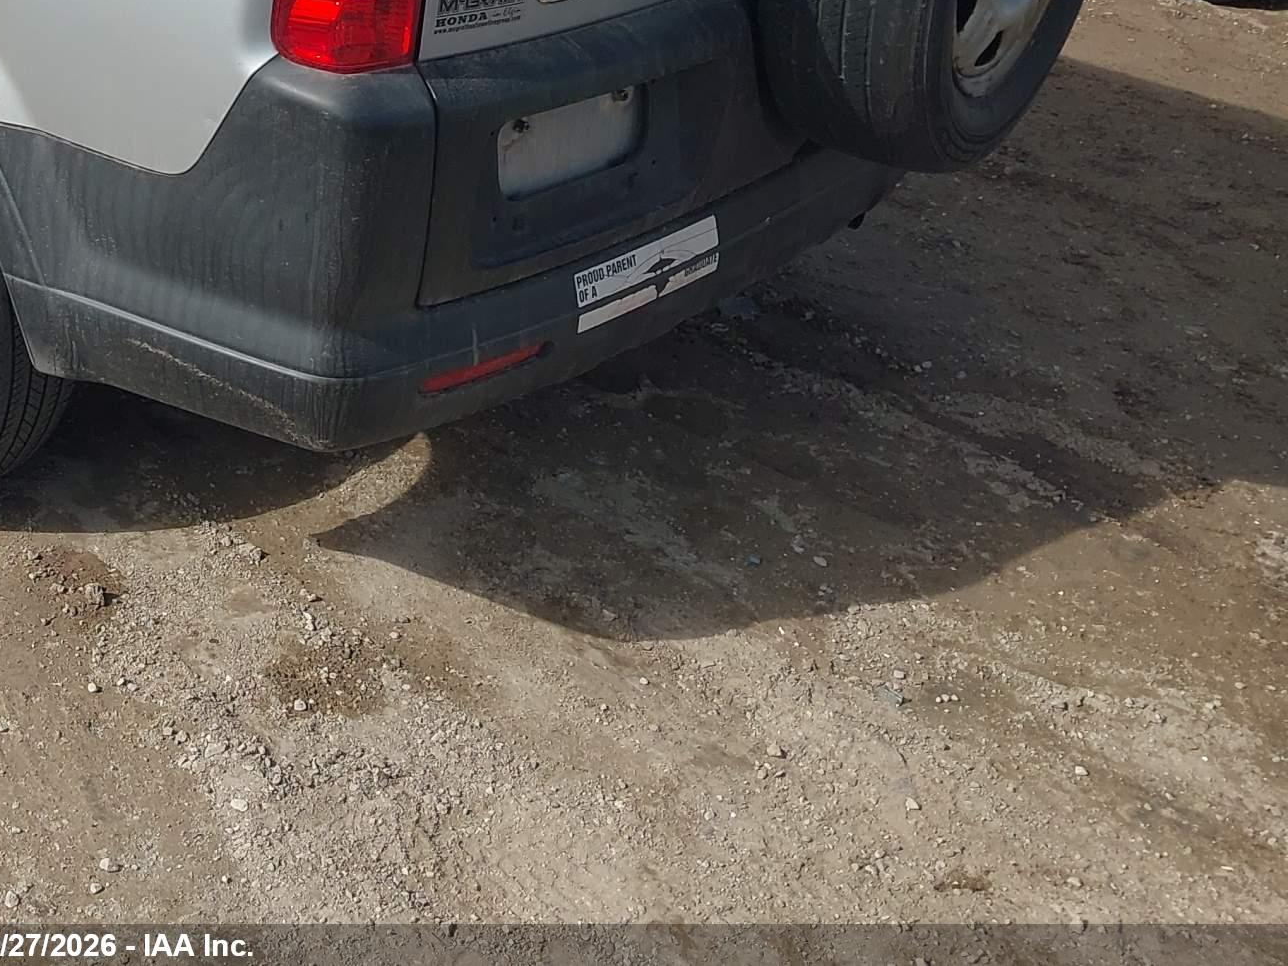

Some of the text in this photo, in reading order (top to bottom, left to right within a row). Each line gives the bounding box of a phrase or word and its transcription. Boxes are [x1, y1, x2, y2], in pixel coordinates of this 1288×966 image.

[435, 12, 488, 28] HONDA
[576, 255, 637, 289] PROUD PARENT
[579, 286, 598, 303] OF A
